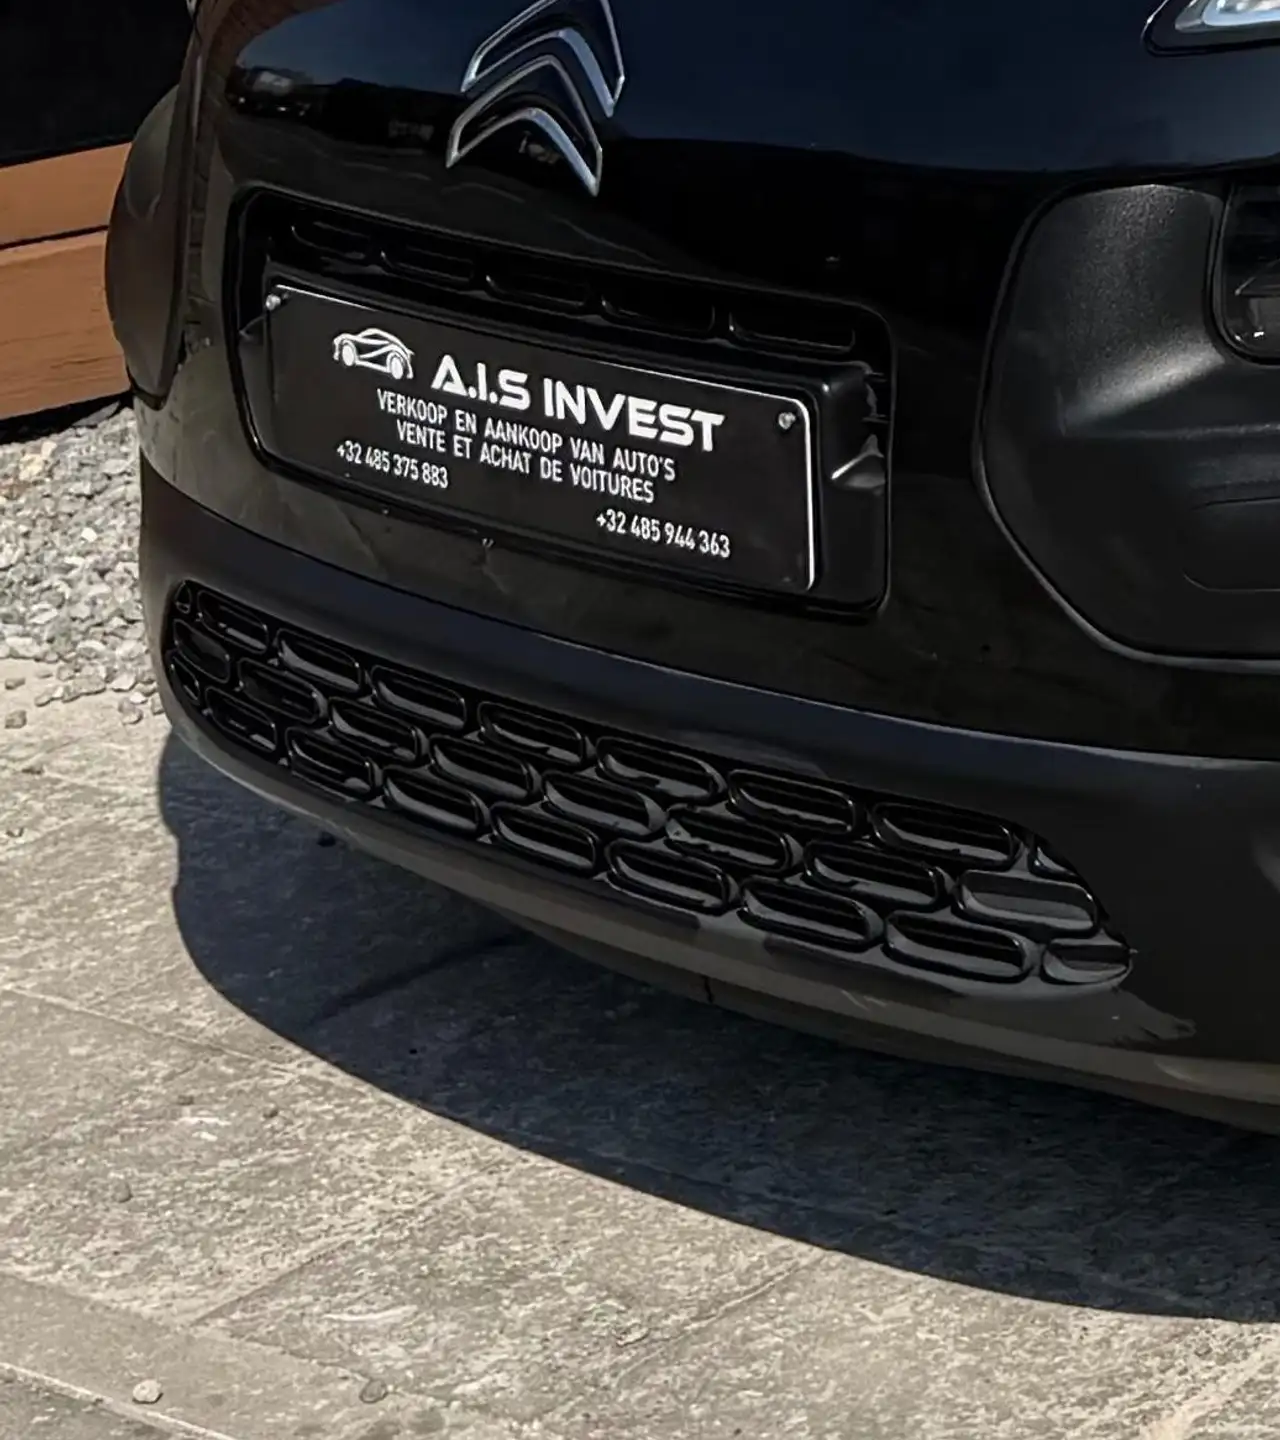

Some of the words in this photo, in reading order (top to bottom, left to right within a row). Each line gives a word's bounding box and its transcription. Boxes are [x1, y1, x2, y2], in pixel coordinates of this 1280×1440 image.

[376, 388, 448, 426] VERKOOP
[454, 409, 477, 435] EN
[483, 417, 563, 455] AANKOOP
[569, 436, 605, 466] VAN
[612, 447, 676, 482] AUTO'S
[430, 354, 531, 411] A.I.S
[543, 377, 725, 452] INVEST
[336, 440, 362, 465] +32
[364, 446, 391, 473] 485
[392, 453, 419, 481] 375
[421, 461, 449, 489] 883
[396, 418, 447, 453] VENTE
[452, 434, 473, 460] ET
[479, 441, 532, 475] ACHAT
[539, 455, 563, 483] DE
[569, 462, 655, 504] VOITURES
[596, 508, 627, 535] +32
[630, 514, 661, 543] 485
[664, 522, 696, 550] 944
[698, 529, 731, 558] 363
